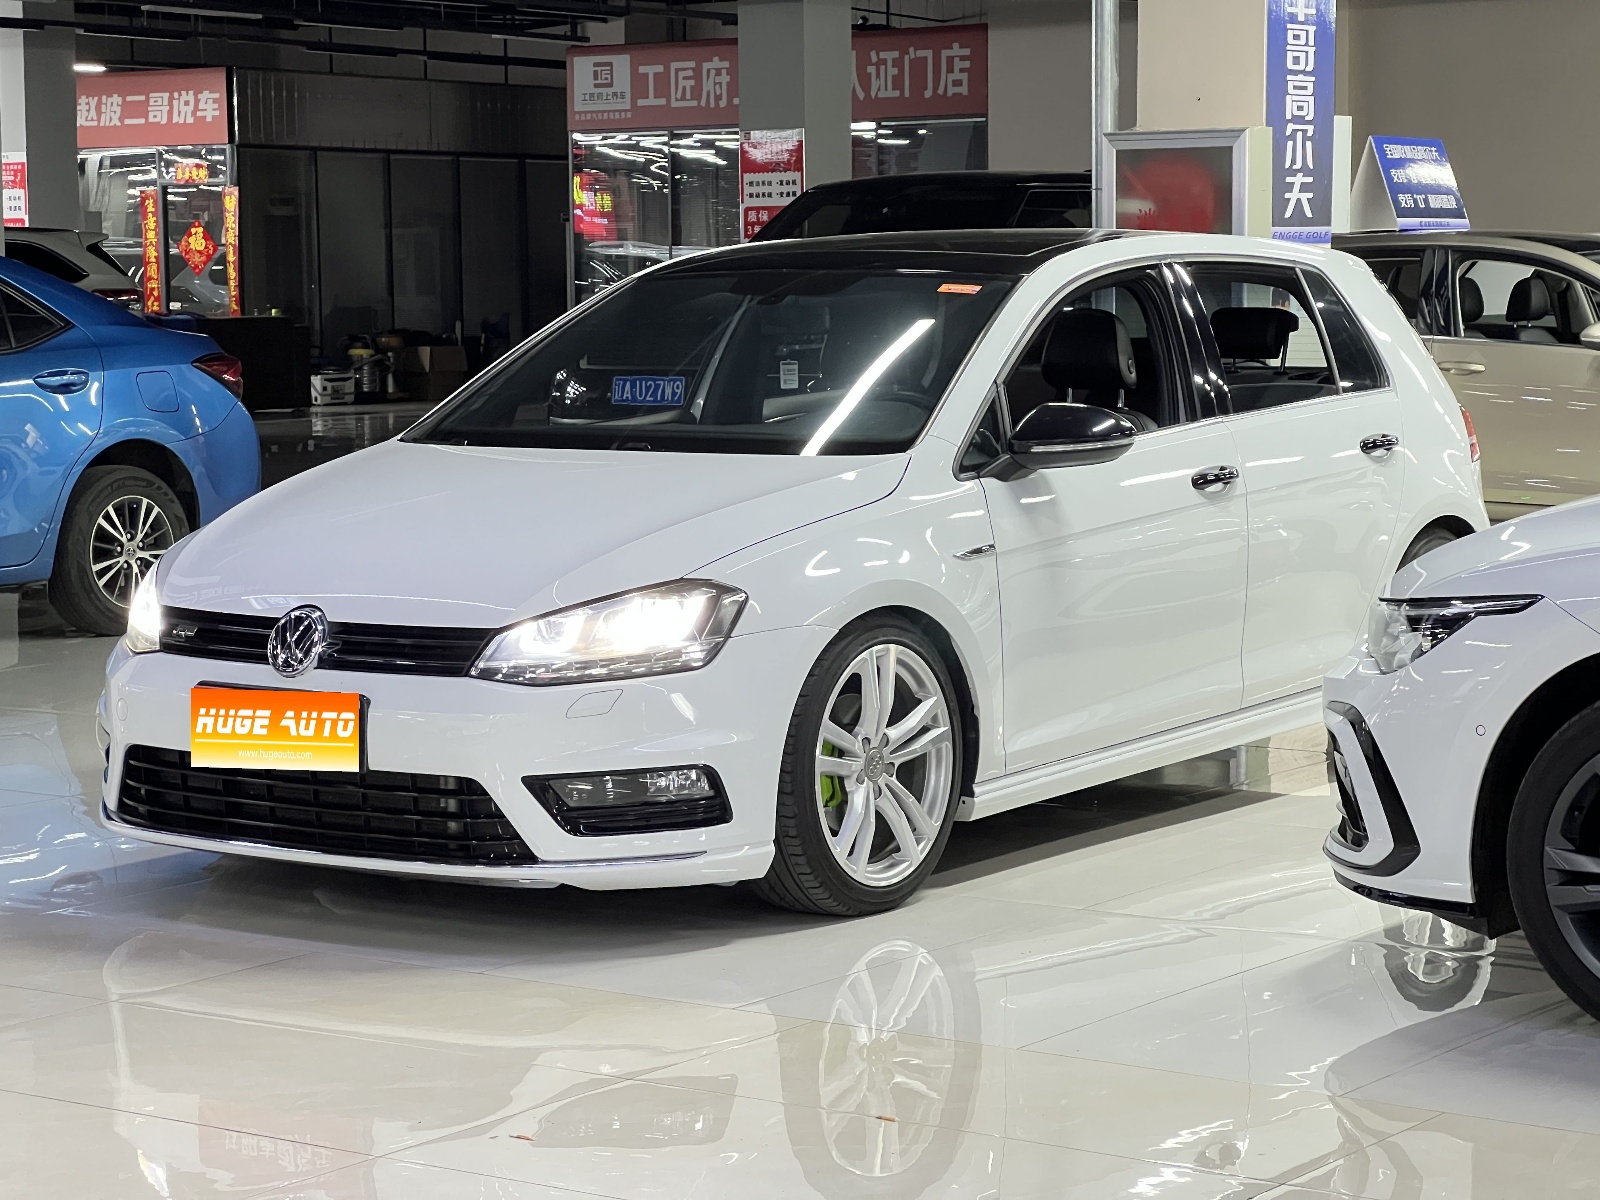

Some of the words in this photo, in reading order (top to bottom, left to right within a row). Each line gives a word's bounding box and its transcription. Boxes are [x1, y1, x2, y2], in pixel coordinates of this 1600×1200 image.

[637, 56, 740, 108] 工匠府
[77, 90, 220, 126] 赵波二哥说车
[747, 210, 769, 222] 质保
[188, 226, 206, 251] 福
[1272, 231, 1304, 240] ENGGE
[1305, 231, 1330, 239] GOLF
